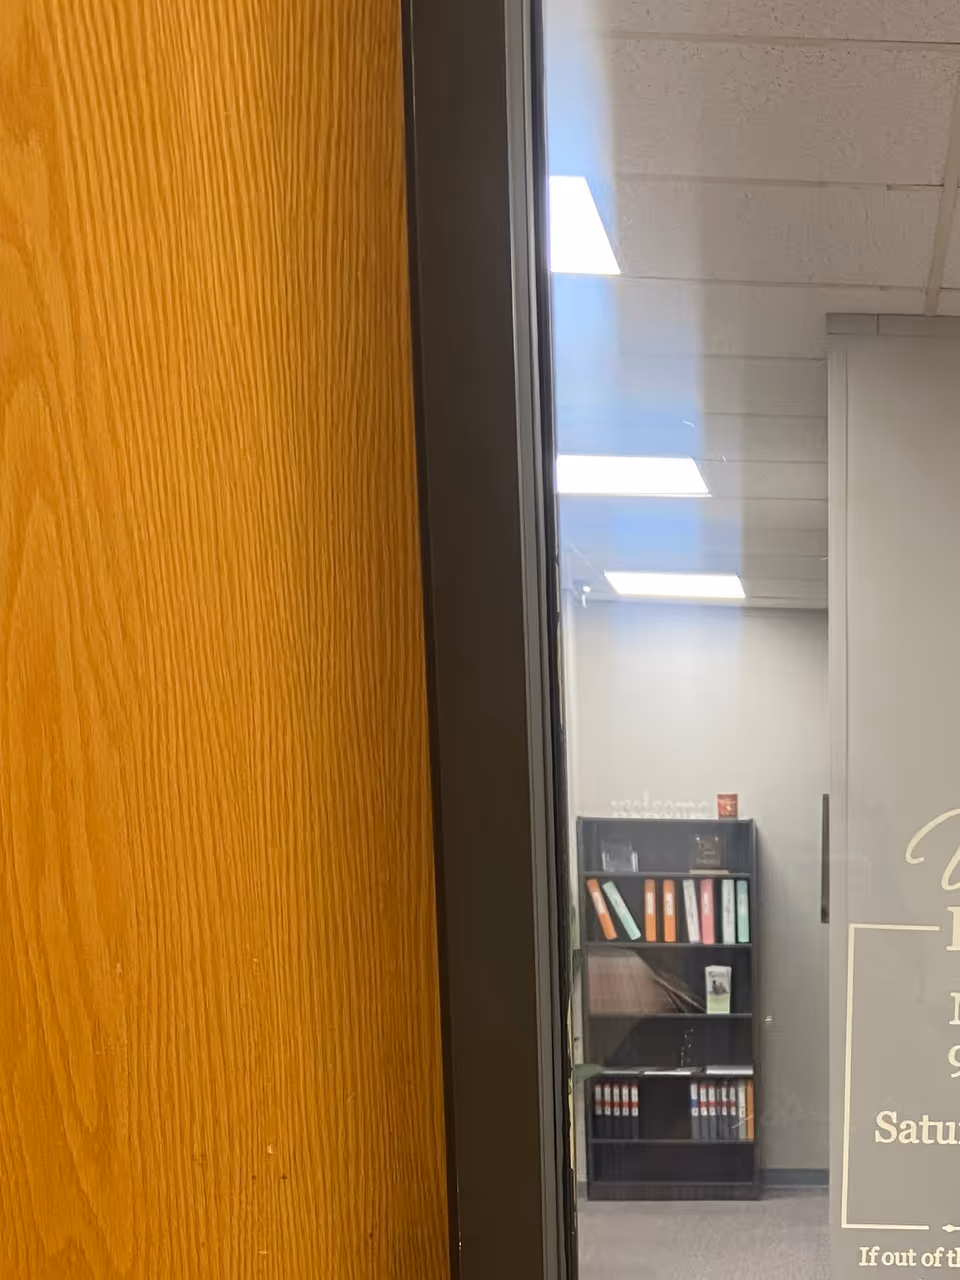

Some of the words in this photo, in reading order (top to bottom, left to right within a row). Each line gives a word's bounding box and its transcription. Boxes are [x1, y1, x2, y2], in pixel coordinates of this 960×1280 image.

[858, 1246, 880, 1266] If
[881, 1249, 916, 1266] out
[921, 1247, 944, 1267] of
